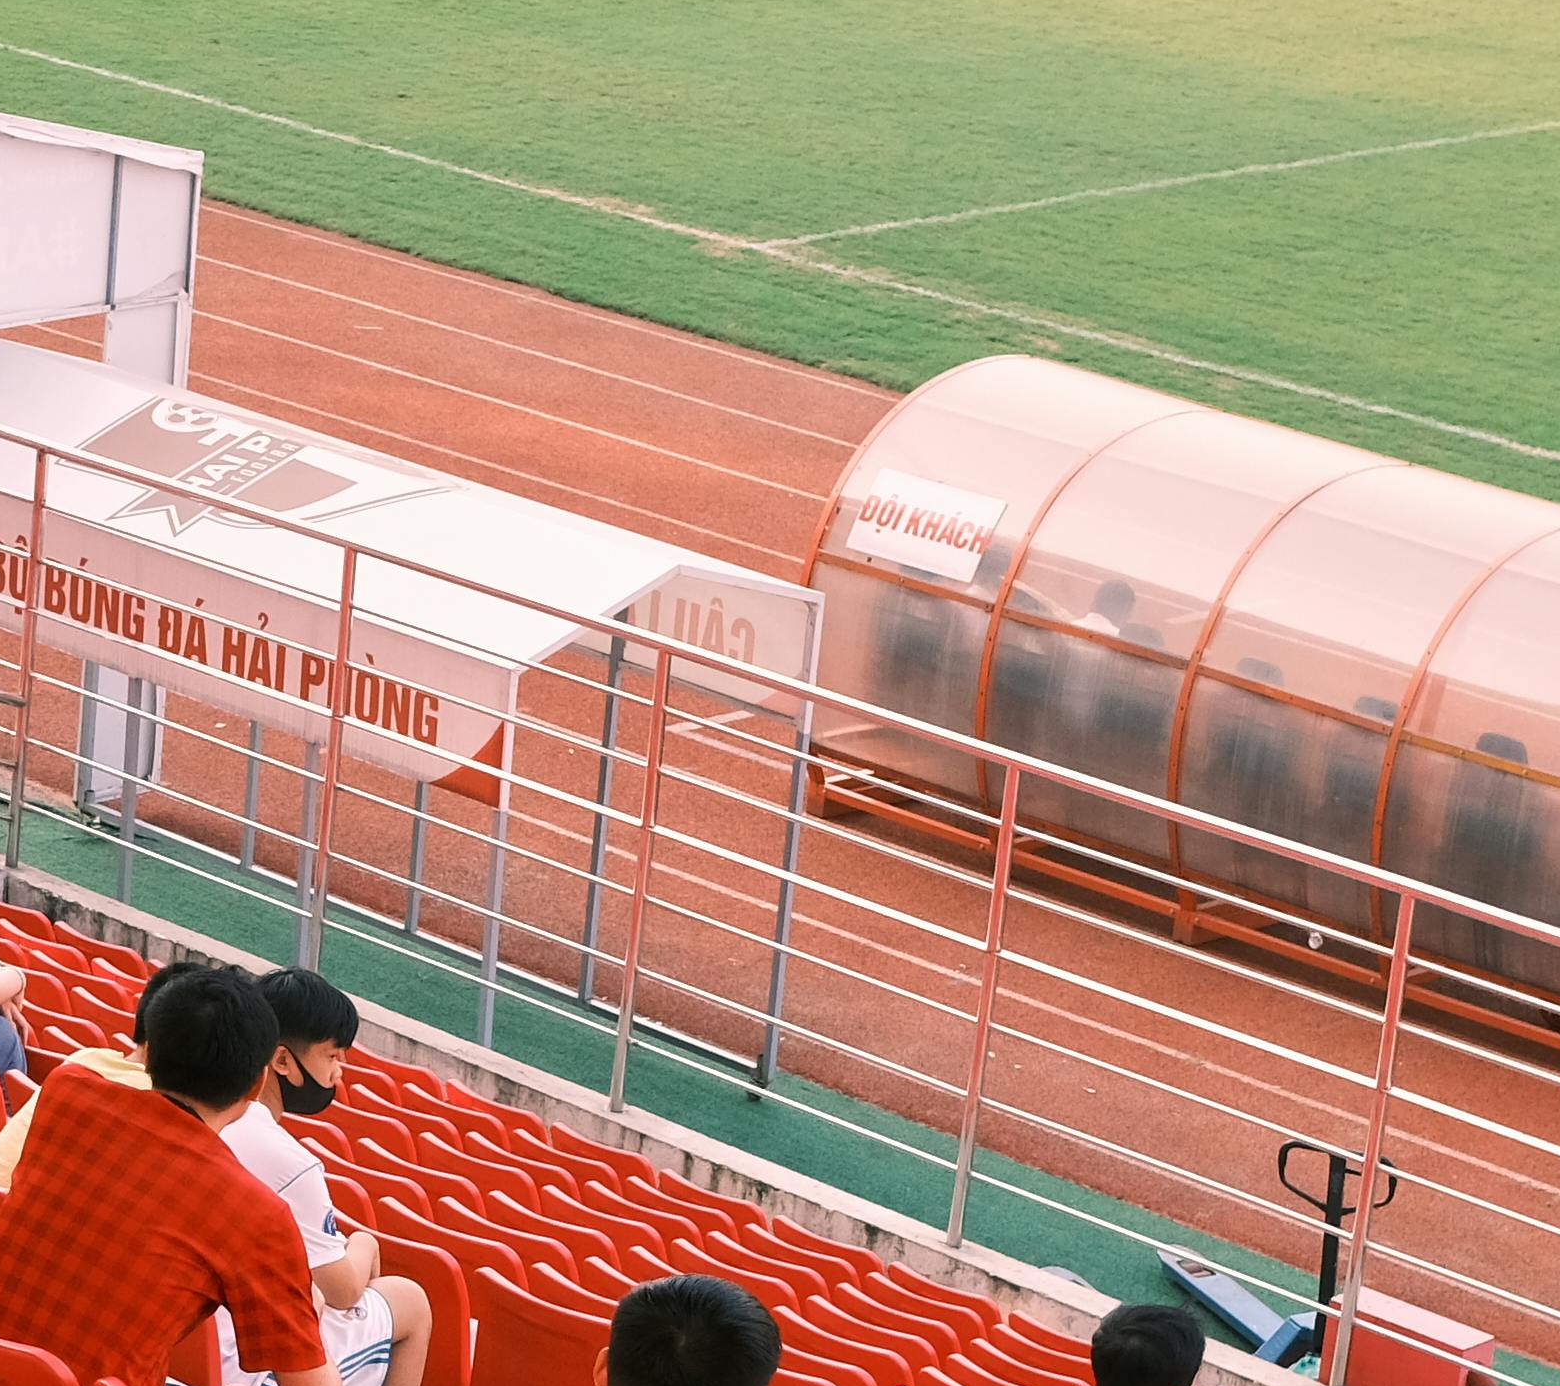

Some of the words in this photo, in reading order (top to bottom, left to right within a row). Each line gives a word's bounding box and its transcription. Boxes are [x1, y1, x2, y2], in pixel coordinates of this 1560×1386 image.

[858, 493, 907, 534] ĐỘI
[903, 506, 995, 555] KHÁCH
[43, 556, 145, 642] BÓNG
[157, 597, 208, 666] ĐÁ
[220, 612, 287, 693] HẢI
